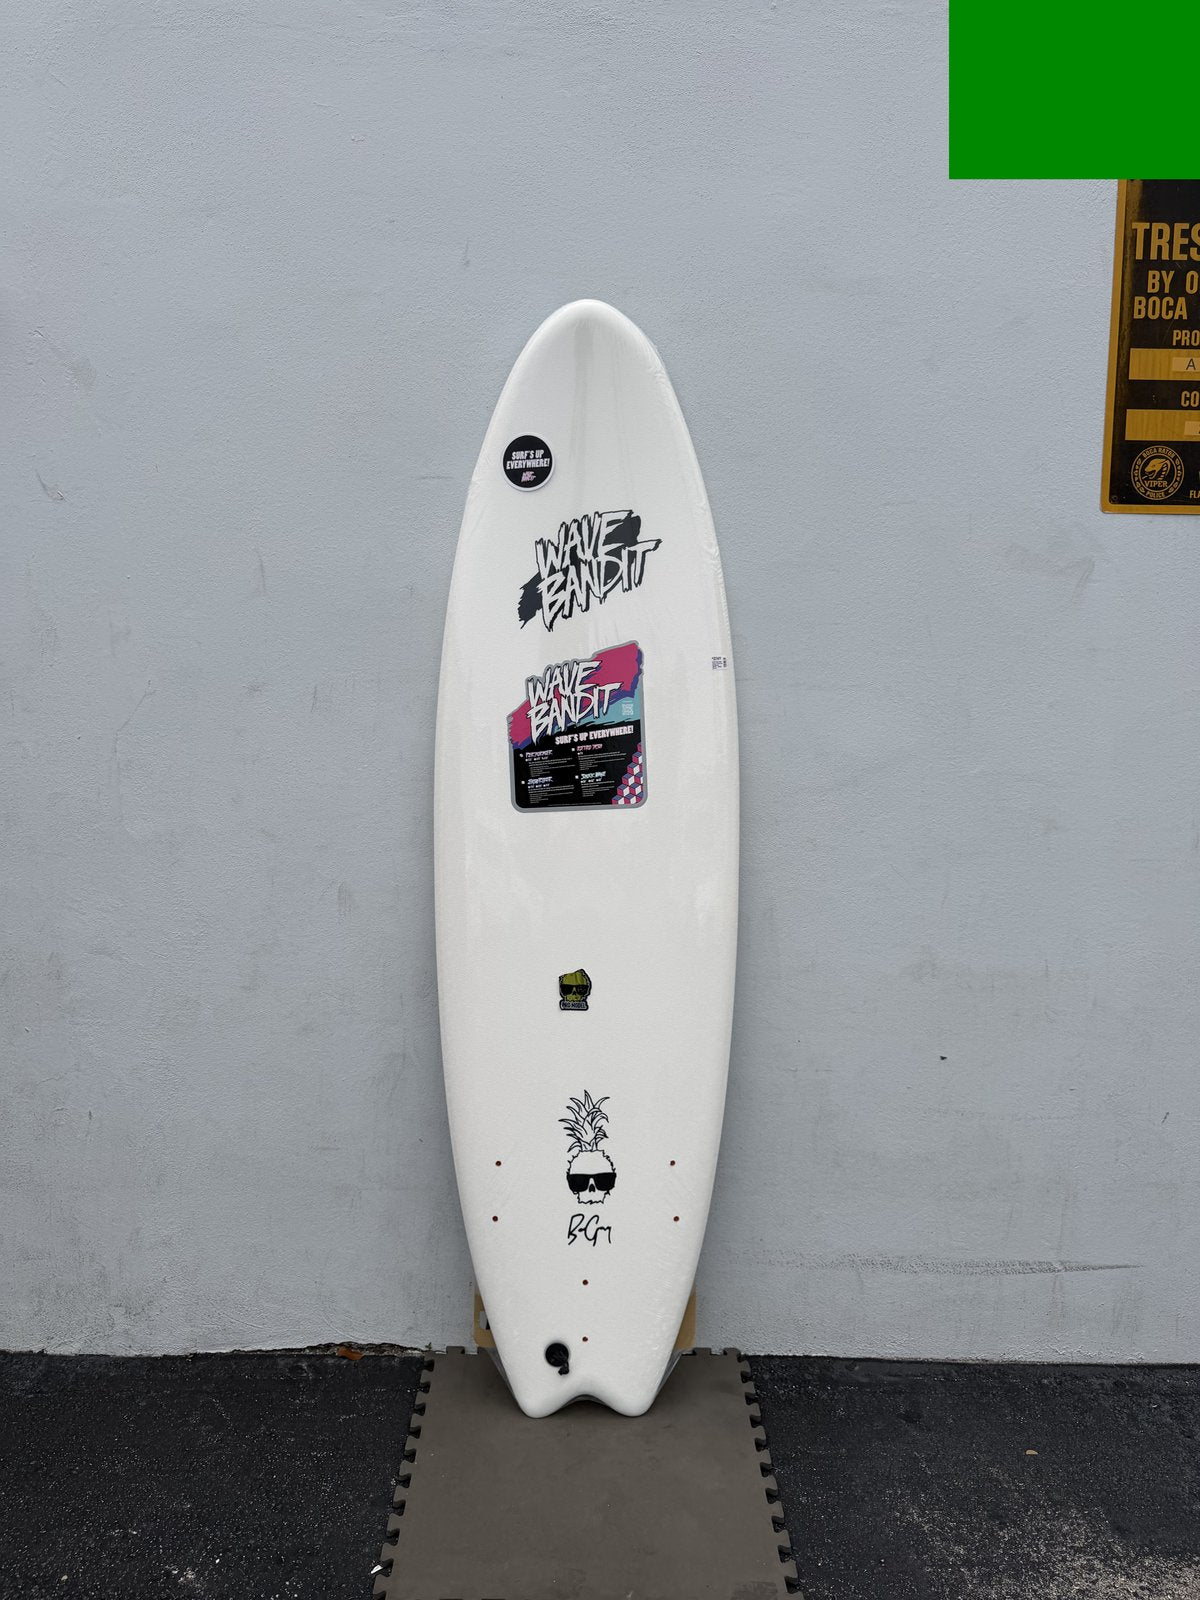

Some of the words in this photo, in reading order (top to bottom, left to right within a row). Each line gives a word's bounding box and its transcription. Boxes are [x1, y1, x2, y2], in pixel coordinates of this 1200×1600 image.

[1147, 270, 1174, 293] BY
[1133, 296, 1187, 319] BOCA
[1172, 330, 1200, 346] PRO
[1181, 391, 1200, 407] CO
[511, 450, 535, 460] SURF'S
[535, 449, 545, 459] UP
[1142, 448, 1157, 459] BOCA
[506, 458, 550, 470] EVERYWHERE!
[1144, 480, 1168, 488] VIPER
[535, 510, 633, 579] WAVE
[536, 539, 662, 632] BANDIT
[528, 660, 602, 704] WAVE
[527, 682, 624, 746] BANDIT
[555, 732, 579, 745] SURF'S
[579, 731, 589, 742] UP
[589, 725, 634, 740] EVERYWHERE!
